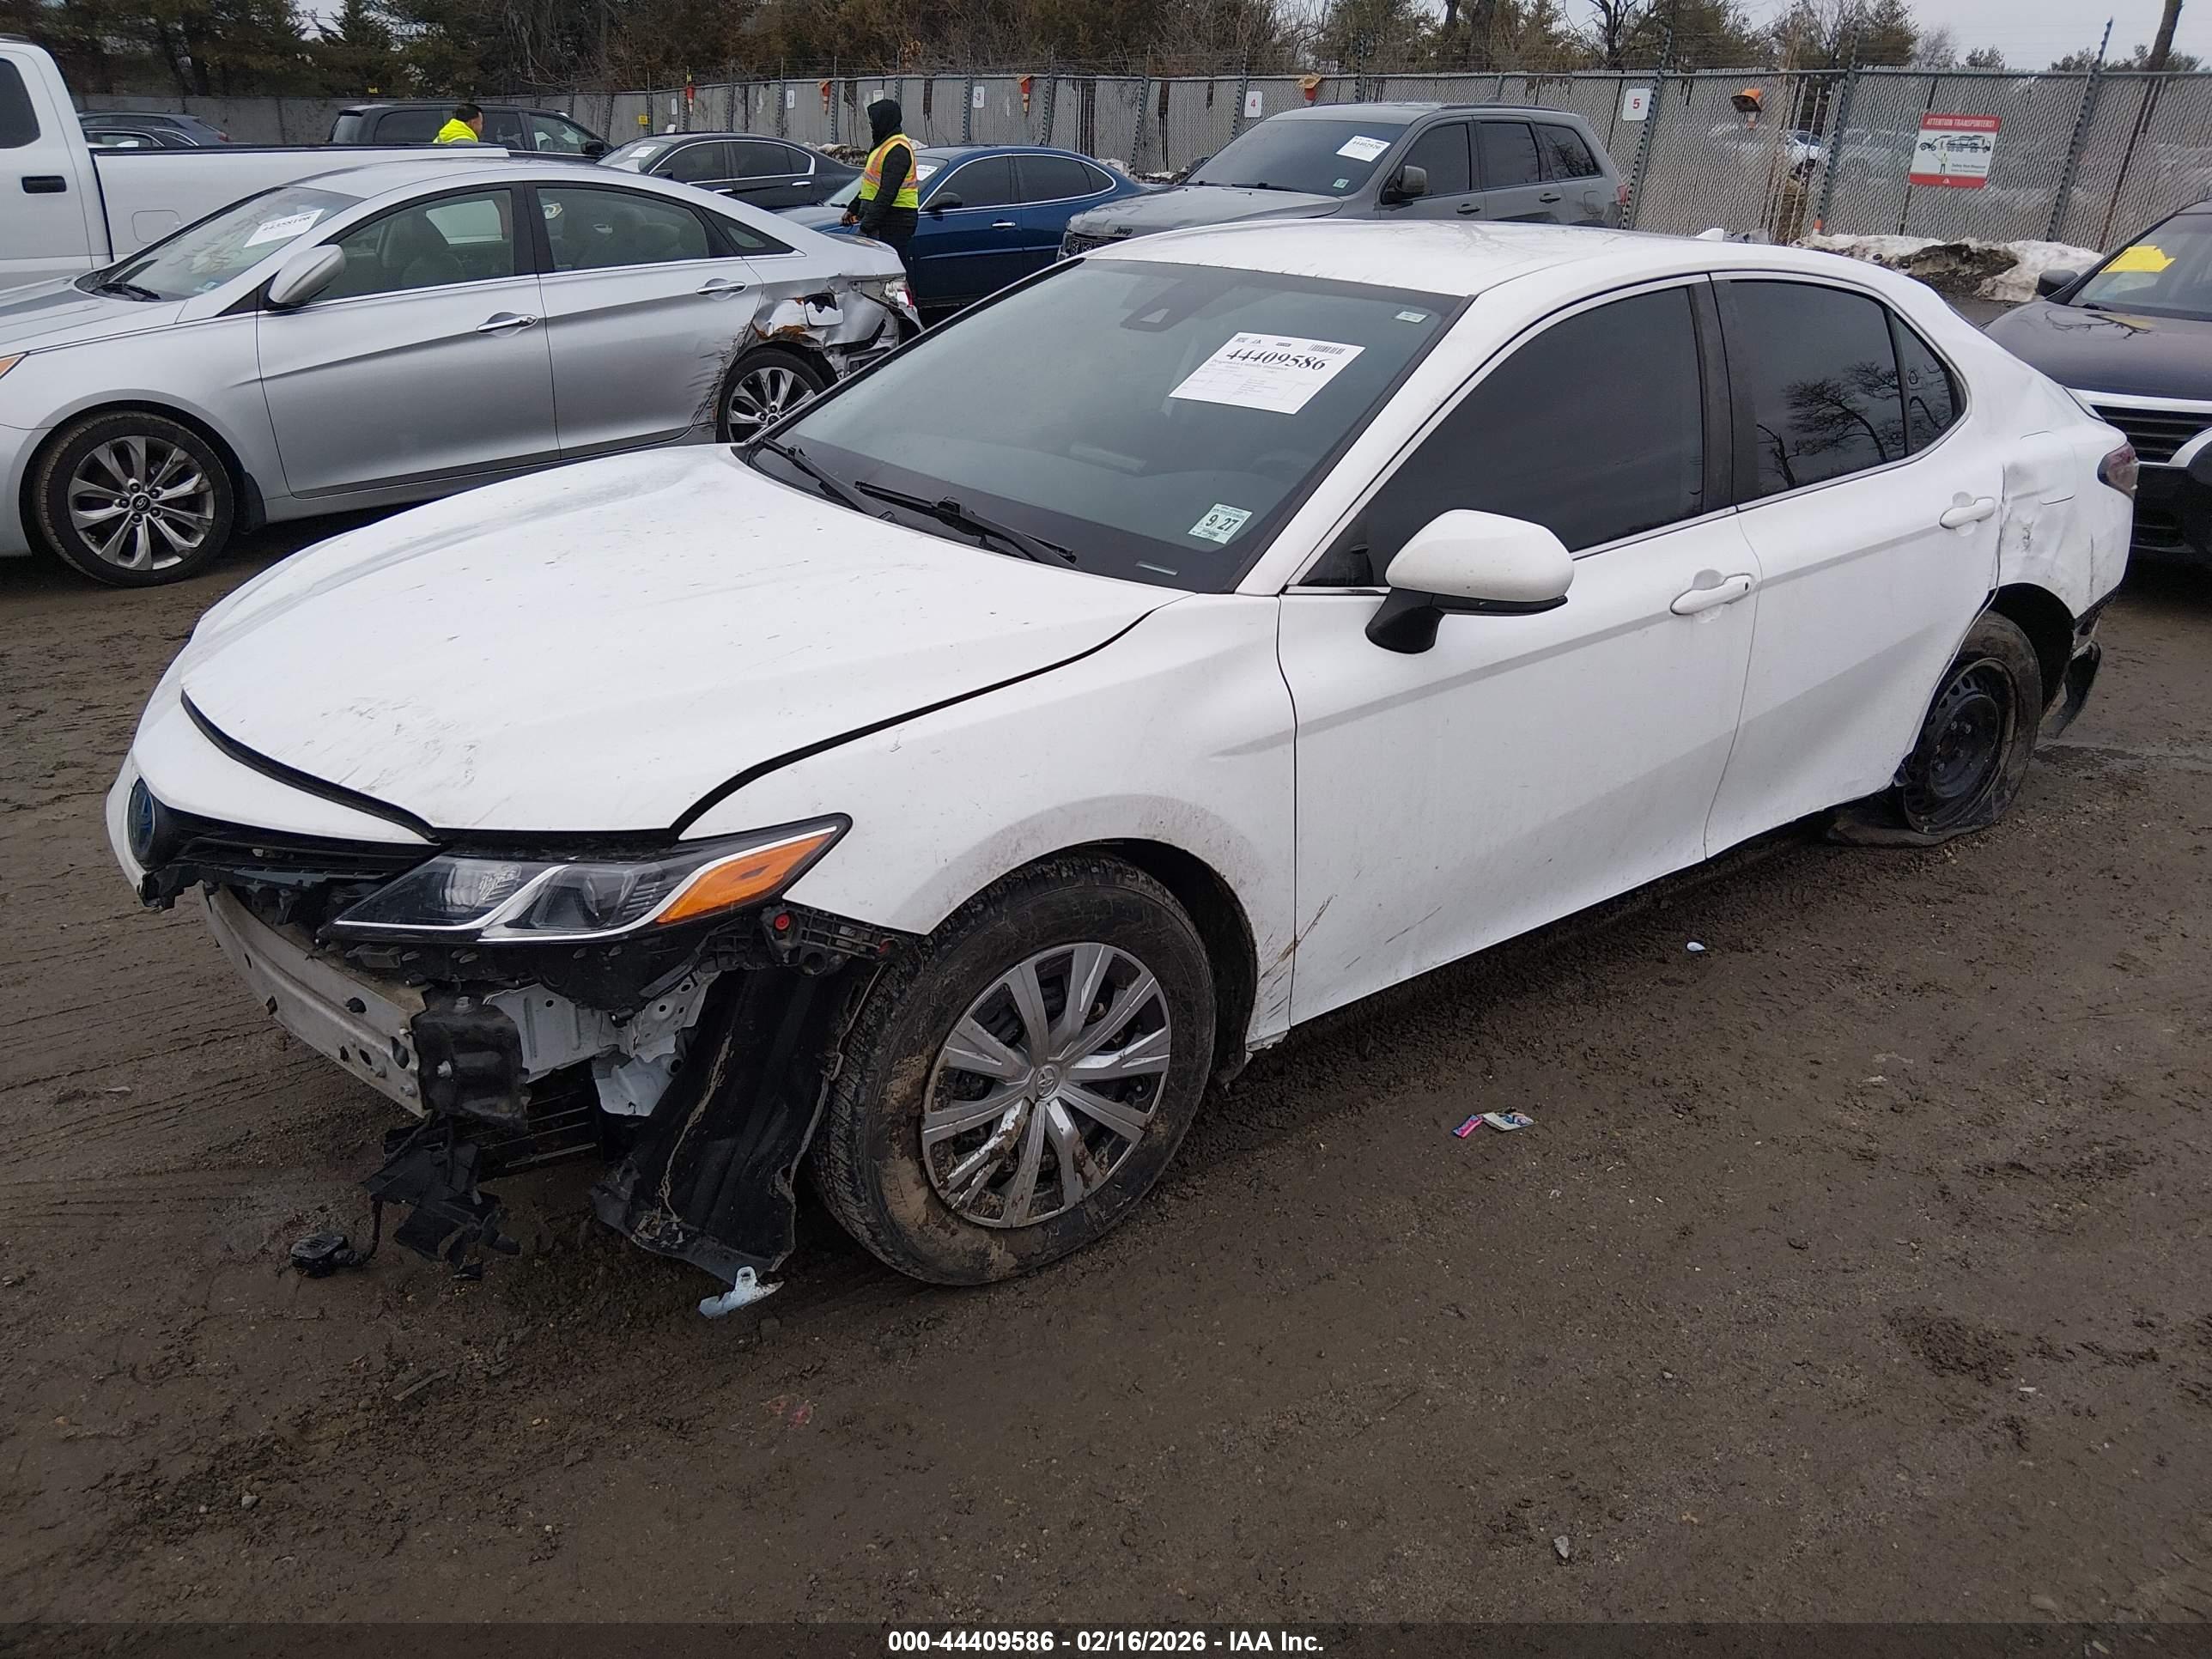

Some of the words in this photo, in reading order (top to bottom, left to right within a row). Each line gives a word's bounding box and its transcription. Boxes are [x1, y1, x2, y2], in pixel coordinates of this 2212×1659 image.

[1250, 99, 1256, 107] 4
[1632, 98, 1640, 109] 5
[1114, 227, 1133, 236] Jeep
[1225, 348, 1332, 371] 44409586
[1206, 514, 1218, 526] 9
[1217, 518, 1239, 532] 27
